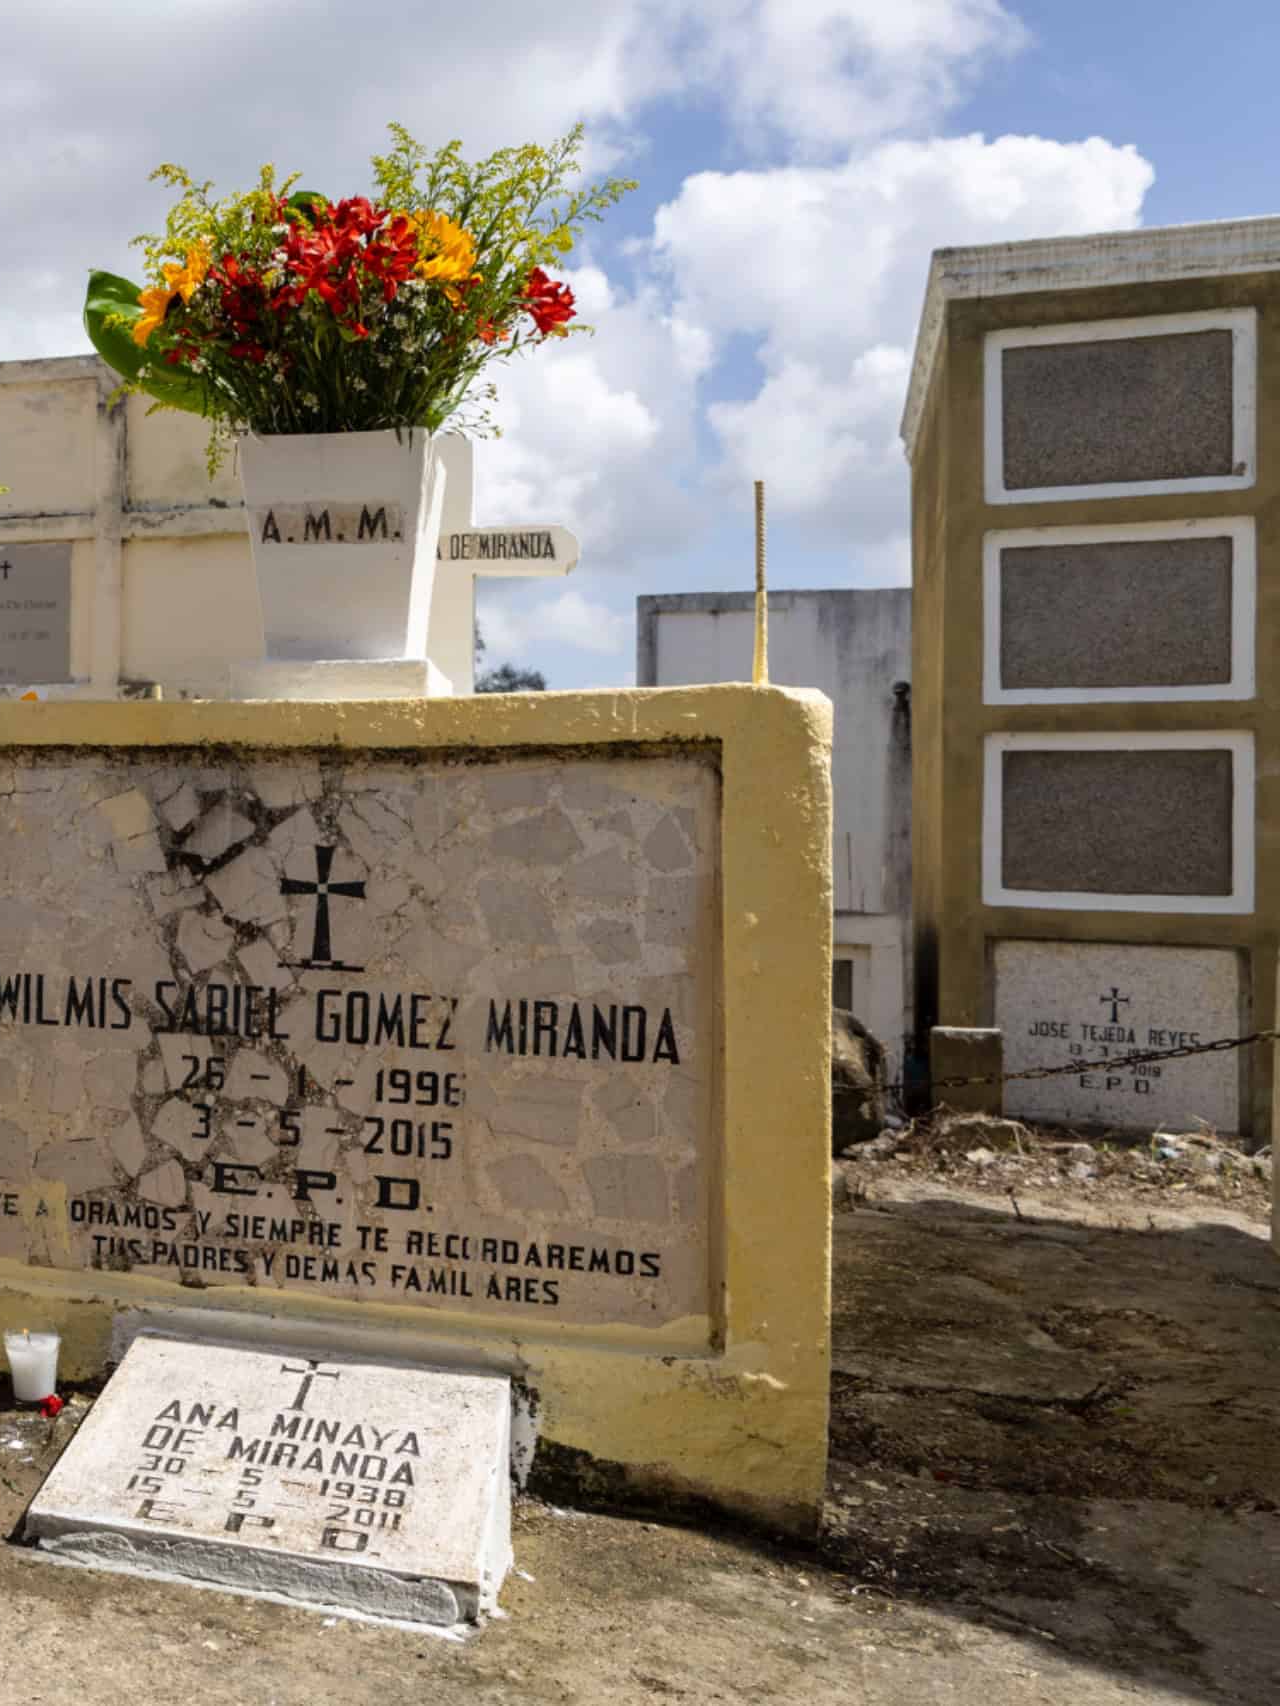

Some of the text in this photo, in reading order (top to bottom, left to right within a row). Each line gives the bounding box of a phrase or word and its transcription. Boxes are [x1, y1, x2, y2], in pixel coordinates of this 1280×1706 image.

[449, 534, 469, 561] DE
[478, 531, 556, 560] MIRANDA
[316, 990, 459, 1050] GOMEZ
[482, 998, 679, 1064] MIRANDA
[1028, 1021, 1200, 1050] JOSE TEJEDA REYES
[361, 1116, 454, 1161] 2015
[198, 1211, 212, 1236] Y
[225, 1215, 340, 1248] SIEMPRE
[357, 1225, 388, 1253] TE
[152, 1241, 250, 1274] PADRES
[263, 1253, 277, 1277] Y
[286, 1256, 378, 1287] DEMAS
[391, 1264, 559, 1306] FAMILARES
[155, 1399, 420, 1457] ANA MINAYA
[141, 1424, 415, 1487] DE MIRANDA
[126, 1474, 166, 1495] 15
[325, 1503, 401, 1531] 2011
[319, 1479, 407, 1508] 1938
